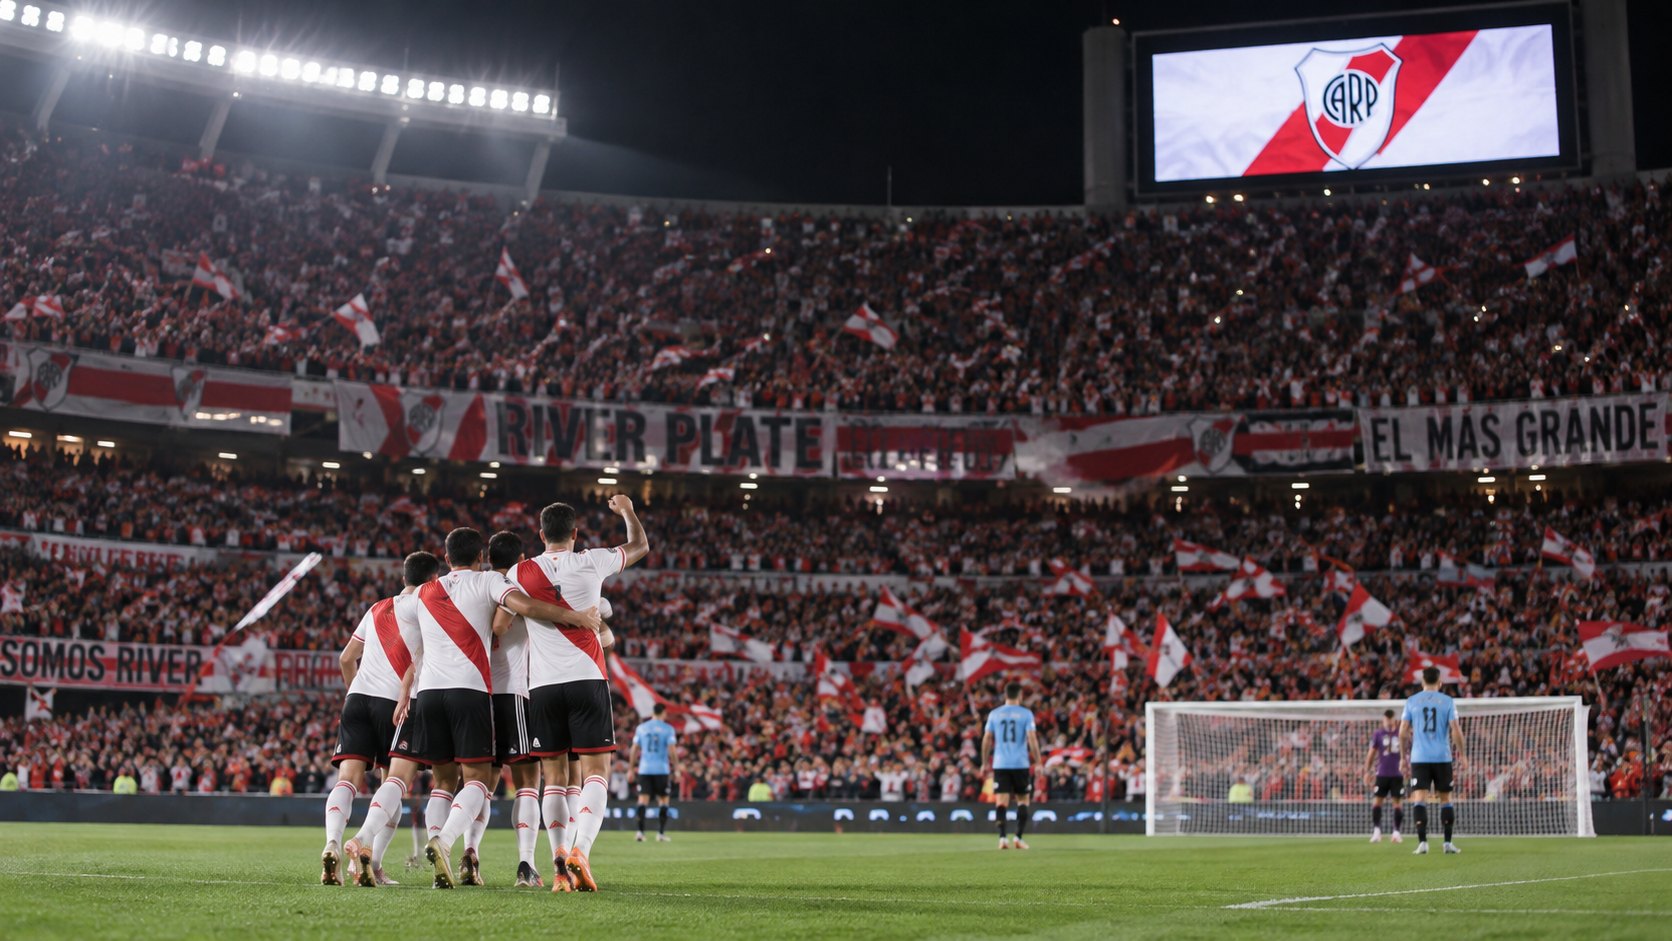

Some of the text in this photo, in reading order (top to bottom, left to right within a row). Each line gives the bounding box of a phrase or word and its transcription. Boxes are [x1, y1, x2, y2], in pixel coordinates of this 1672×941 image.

[1323, 73, 1378, 124] CARP
[497, 402, 647, 463] RIVER
[665, 410, 823, 469] PLATE
[1371, 416, 1412, 462] EL
[1516, 402, 1659, 457] GRANDE
[1, 639, 202, 685] SOMOS RIVER
